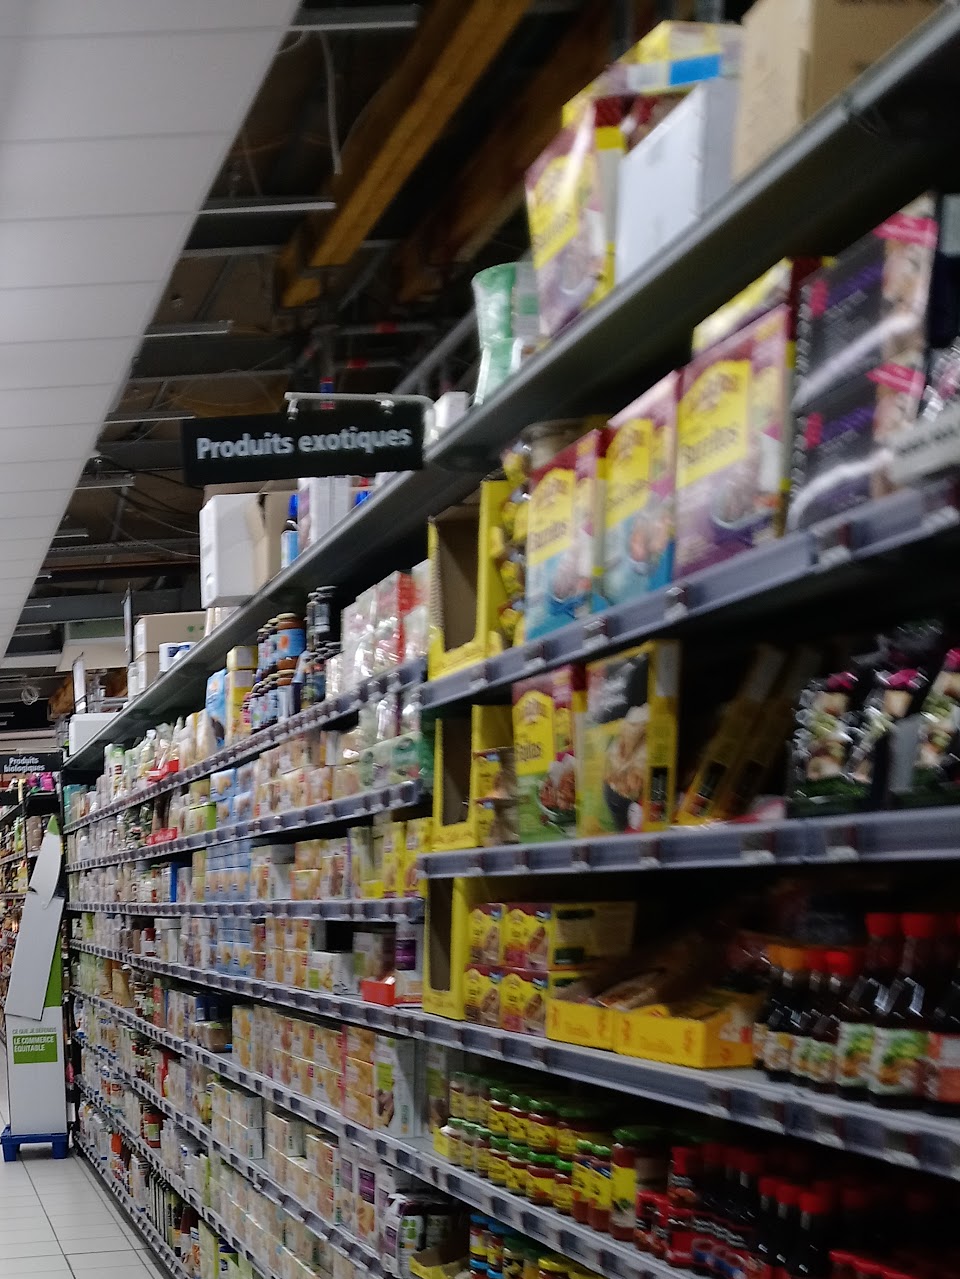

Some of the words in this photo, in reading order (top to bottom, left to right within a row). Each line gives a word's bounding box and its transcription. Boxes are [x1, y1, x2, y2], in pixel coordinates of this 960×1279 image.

[196, 431, 294, 460] Produits
[298, 426, 412, 454] exotiques
[13, 1037, 21, 1045] LE
